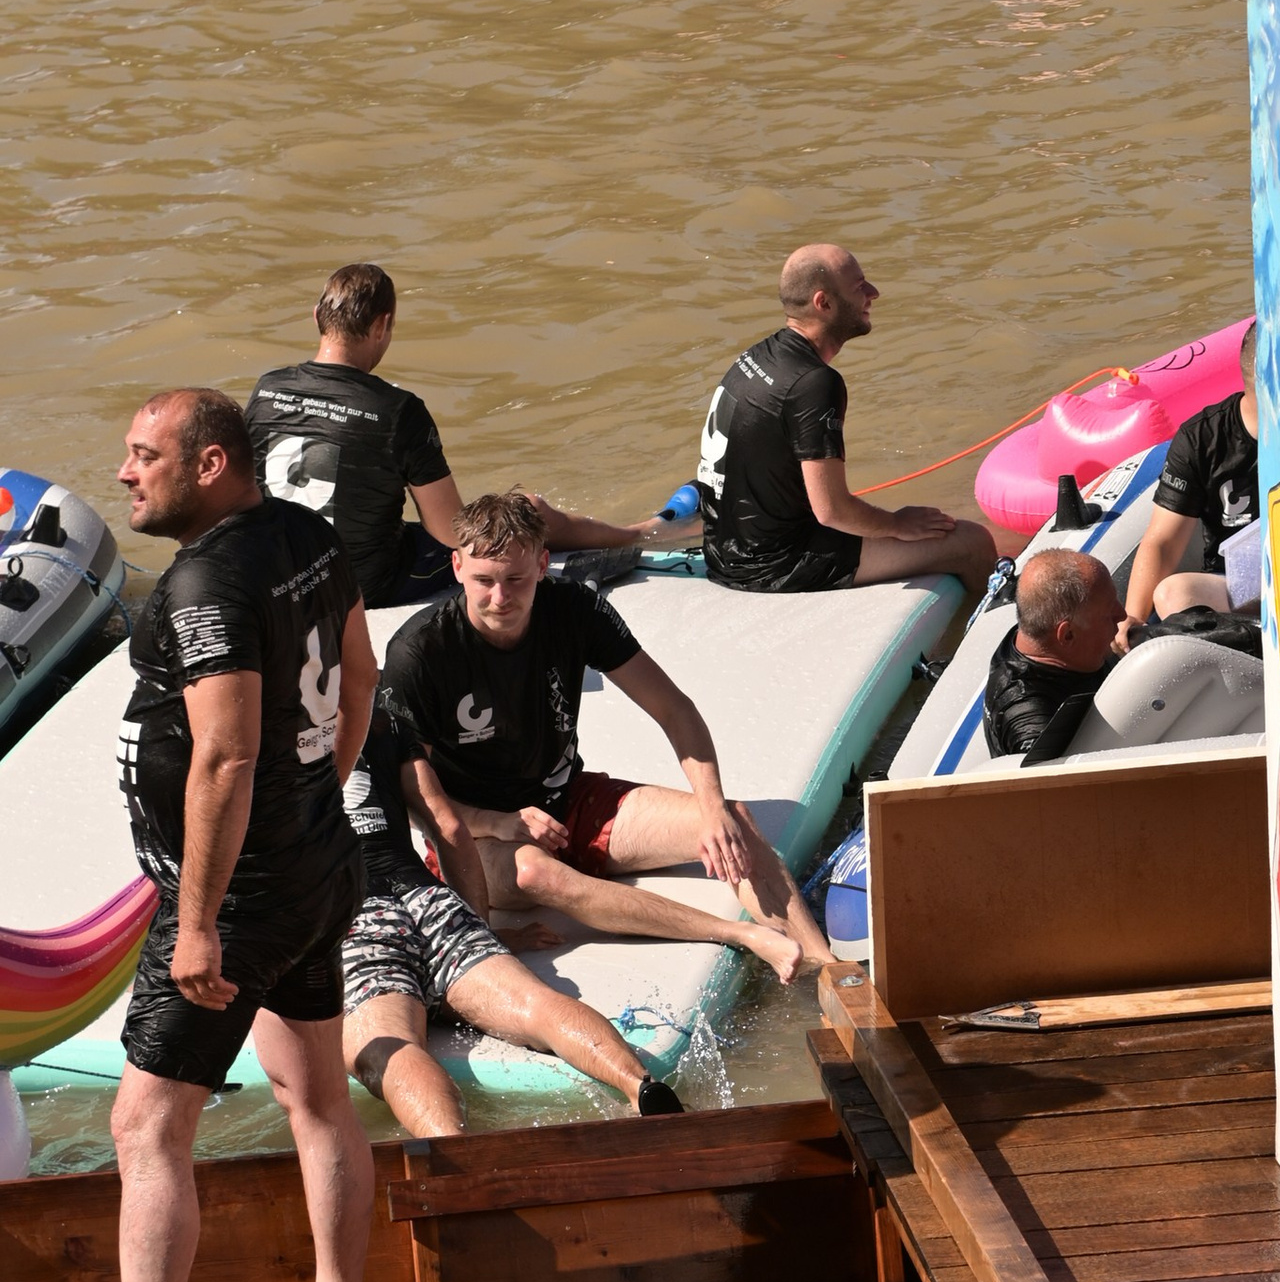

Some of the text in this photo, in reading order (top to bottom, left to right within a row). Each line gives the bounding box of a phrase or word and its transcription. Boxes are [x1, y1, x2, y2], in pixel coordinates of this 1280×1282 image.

[328, 403, 346, 413] wird
[346, 407, 363, 417] nur
[364, 411, 379, 422] mit
